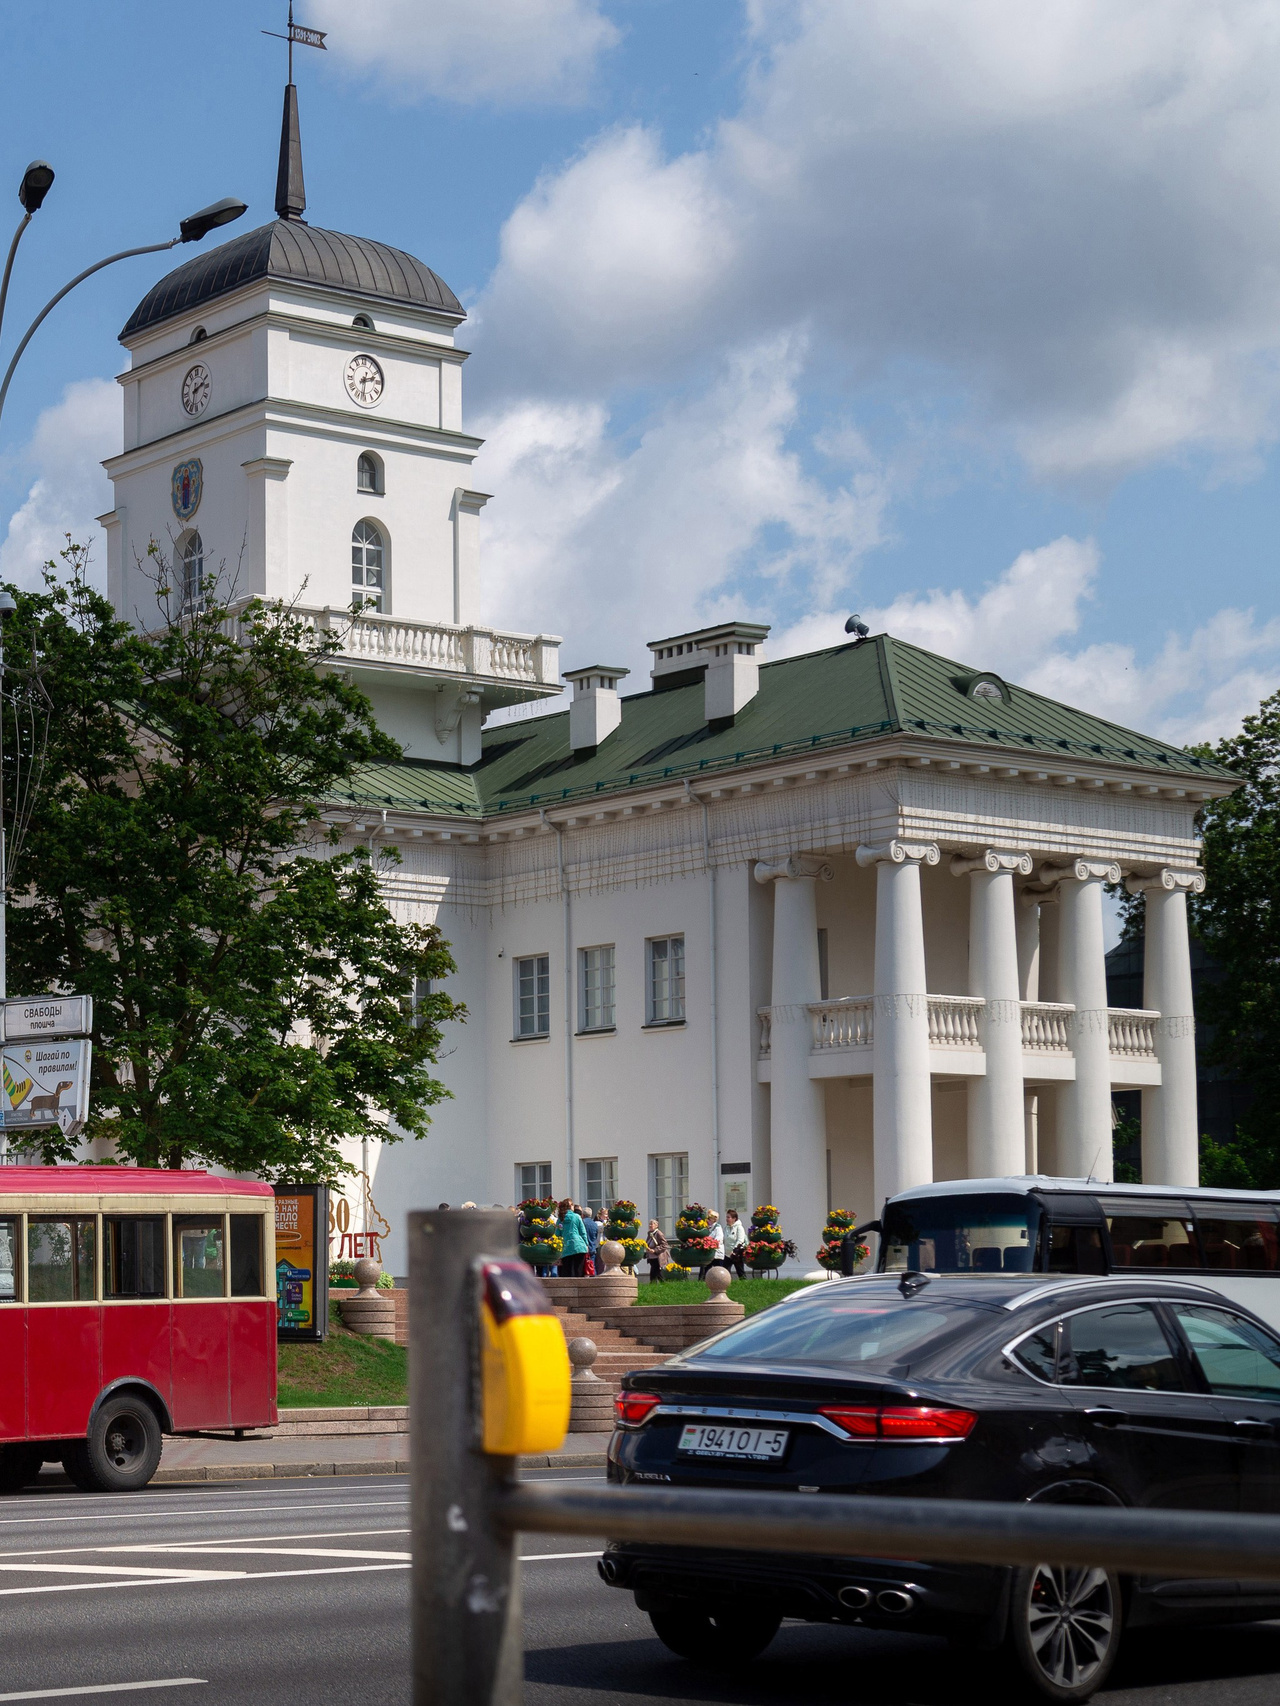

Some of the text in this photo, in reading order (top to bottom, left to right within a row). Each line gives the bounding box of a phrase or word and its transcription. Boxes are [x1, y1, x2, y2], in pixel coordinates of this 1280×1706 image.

[24, 1006, 62, 1018] СВАБОДЫ
[30, 1020, 55, 1029] плошча
[36, 1050, 70, 1061] Шагай по
[38, 1061, 77, 1075] правилам!
[275, 1213, 298, 1221] ЕПЛО
[337, 1232, 379, 1259] ЛЕТ
